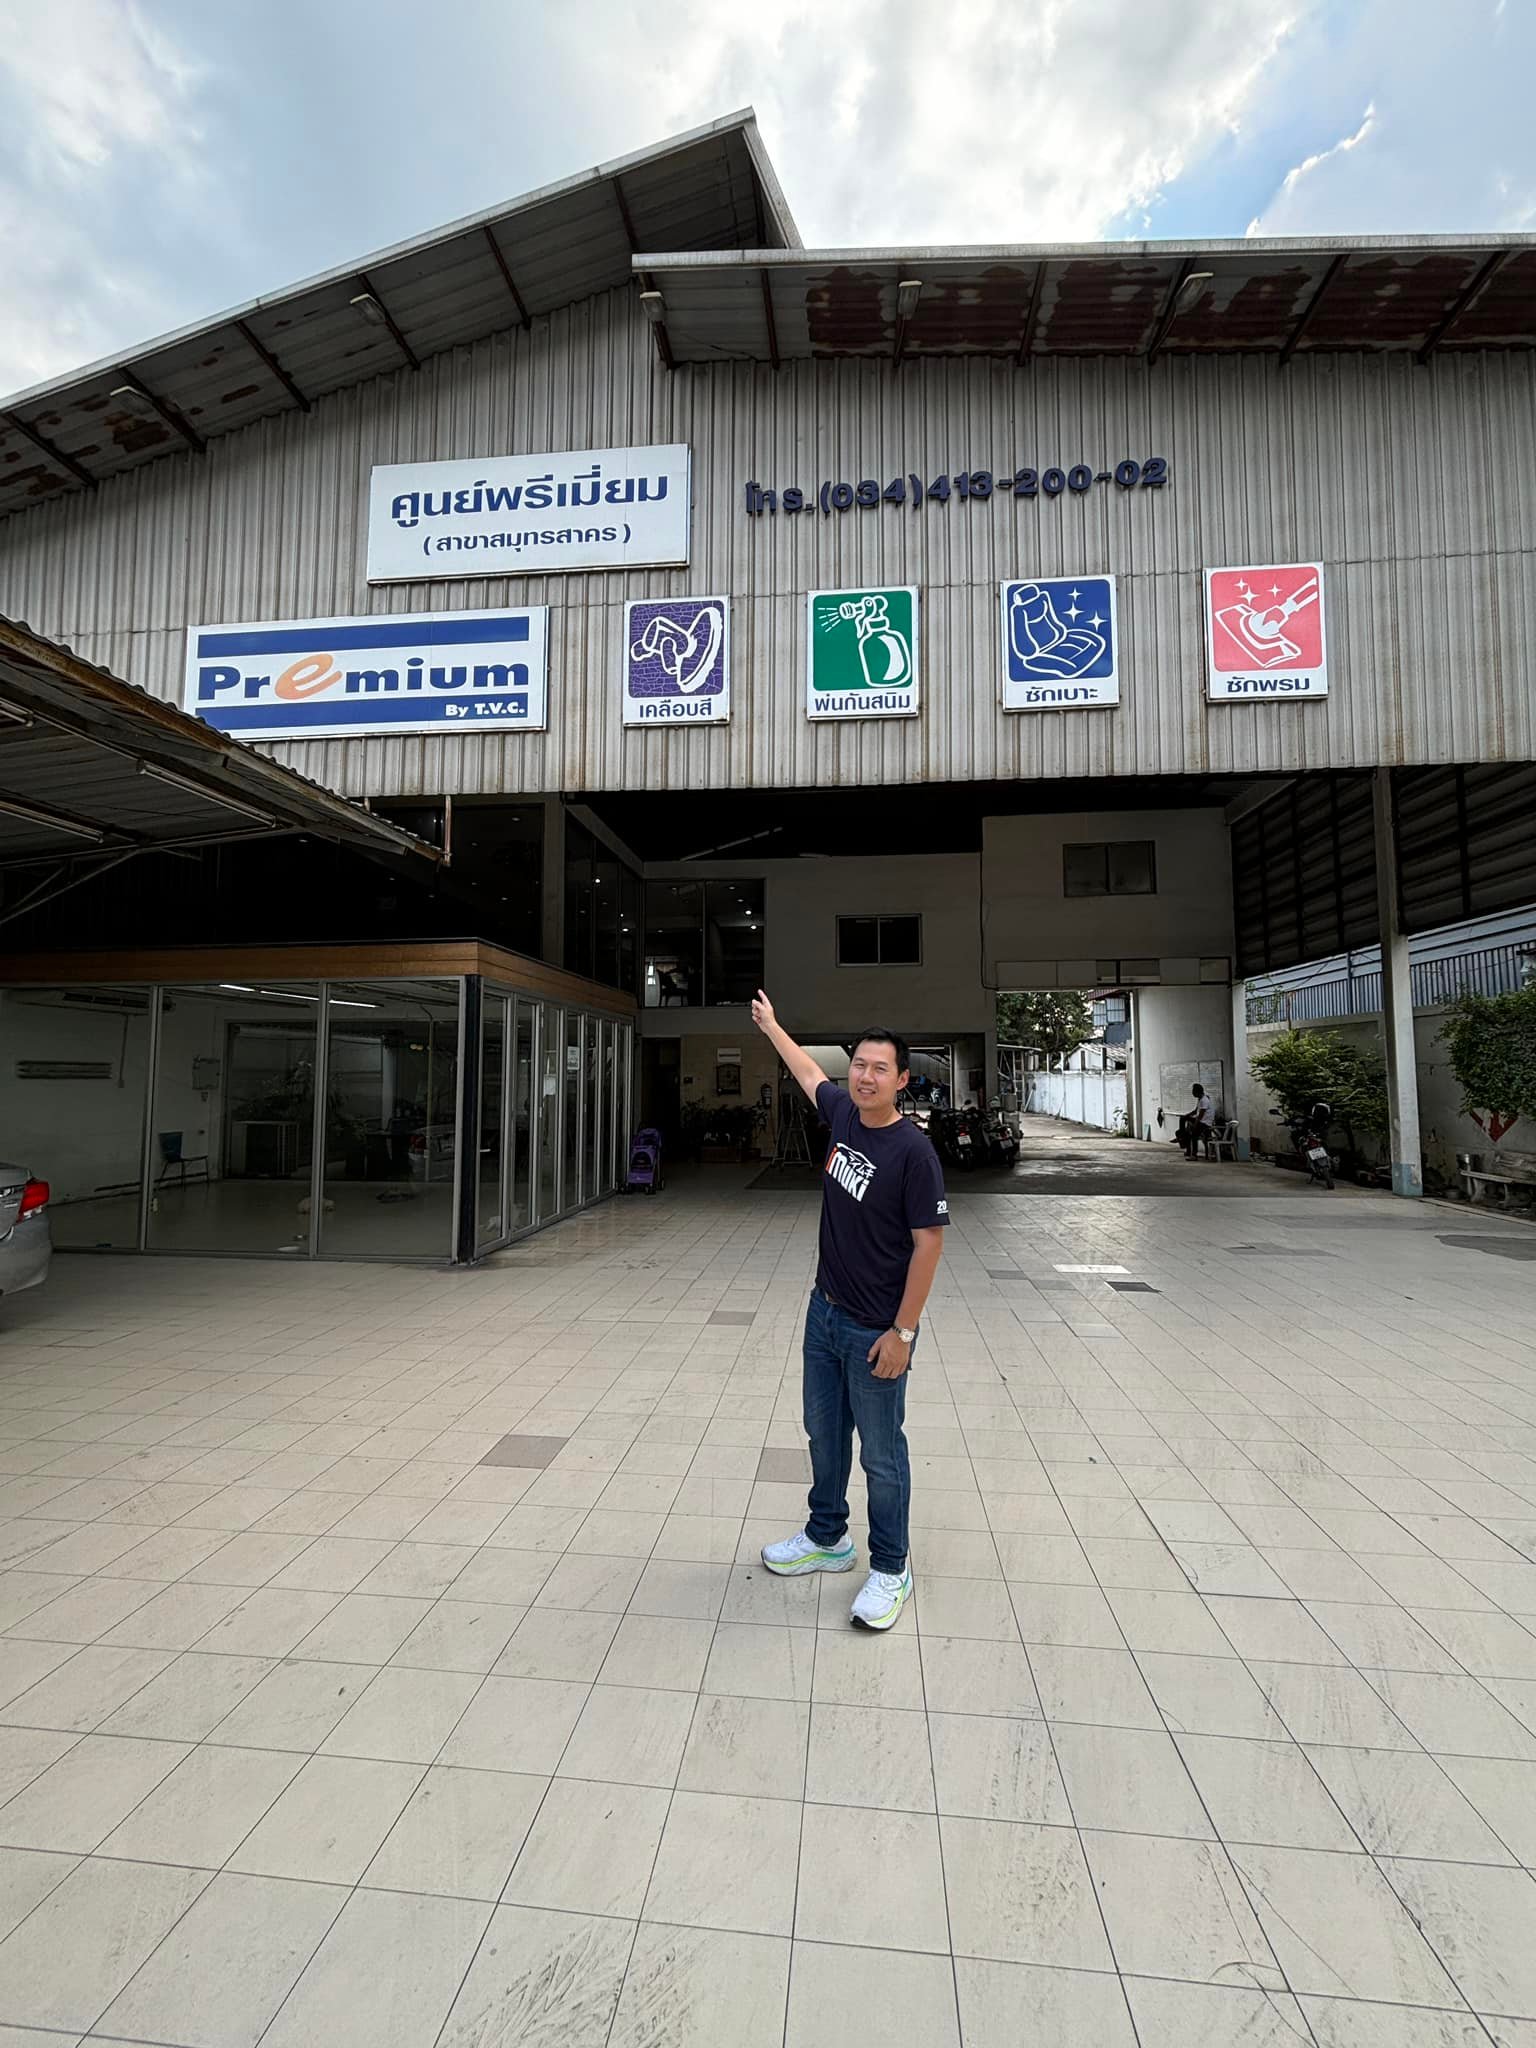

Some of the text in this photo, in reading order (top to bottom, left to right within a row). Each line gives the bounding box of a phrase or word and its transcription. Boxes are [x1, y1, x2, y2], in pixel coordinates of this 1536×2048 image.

[391, 465, 668, 528] ศูนย์พรีเมี่ยม
[198, 653, 529, 701] Premium
[445, 701, 525, 718] By T.V.C.
[639, 697, 712, 718] เคลือบสี
[815, 692, 911, 712] พ่นกันสนิม
